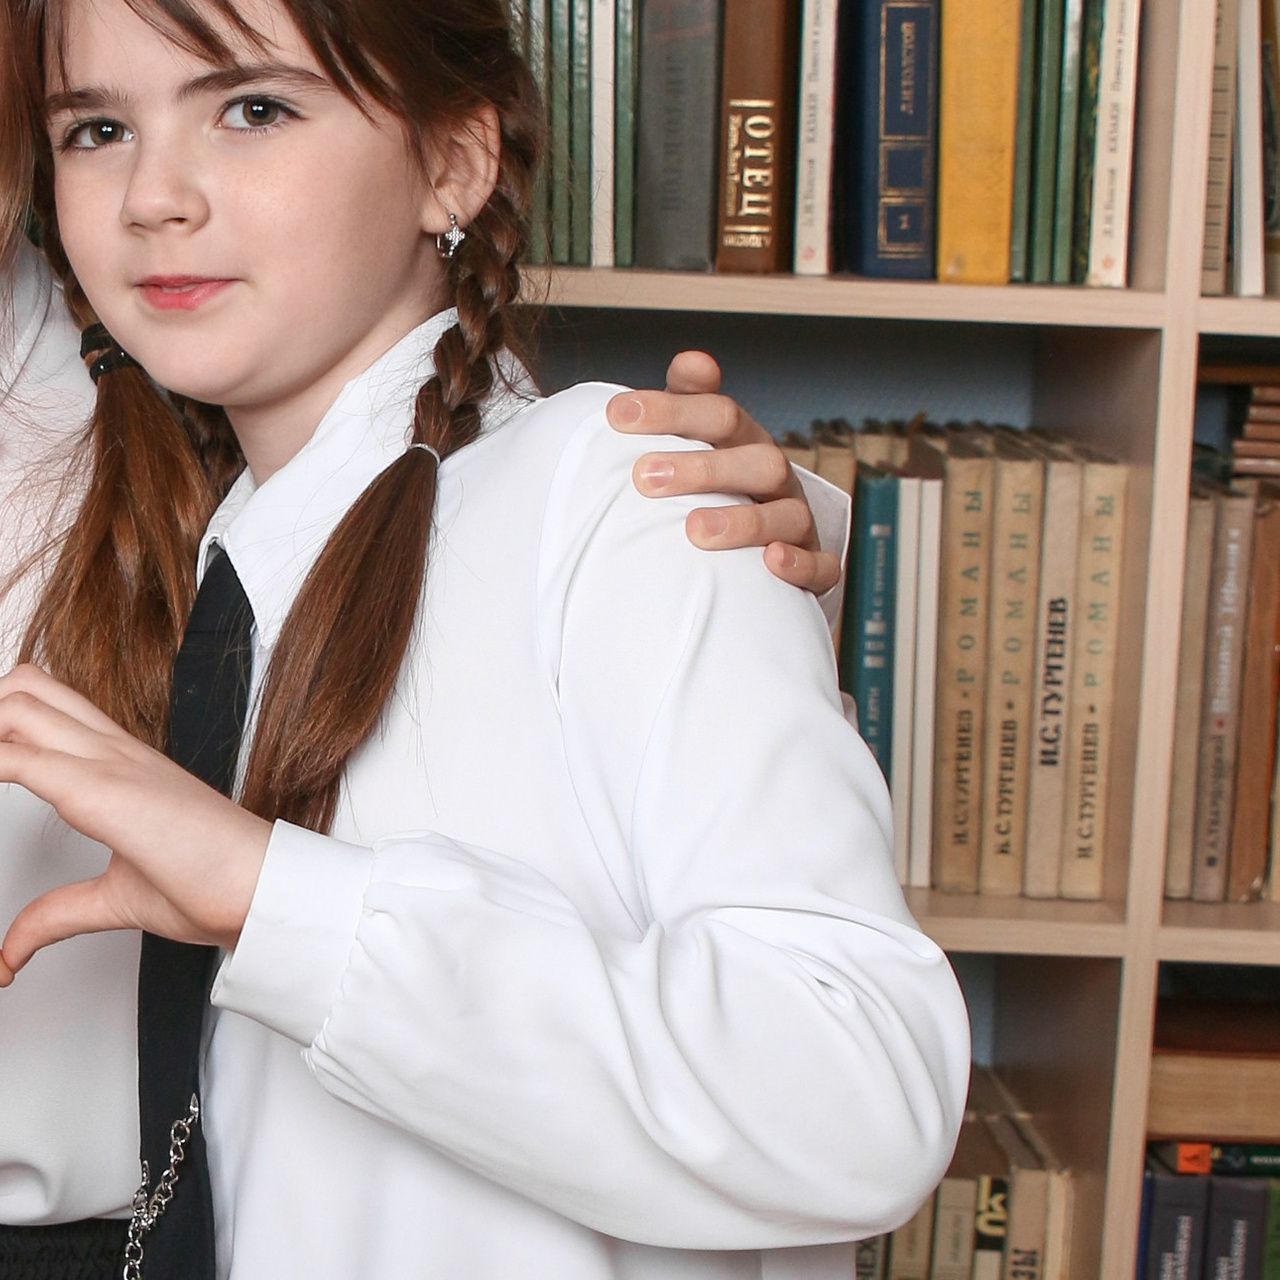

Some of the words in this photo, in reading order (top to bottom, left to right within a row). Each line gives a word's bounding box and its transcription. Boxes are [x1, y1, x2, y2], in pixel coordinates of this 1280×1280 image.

[739, 115, 775, 217] ОТЕЦ
[958, 490, 982, 683] РОМАНЫ
[1002, 492, 1031, 685] РОМАНЫ
[1085, 495, 1114, 686] РОМАНЫ
